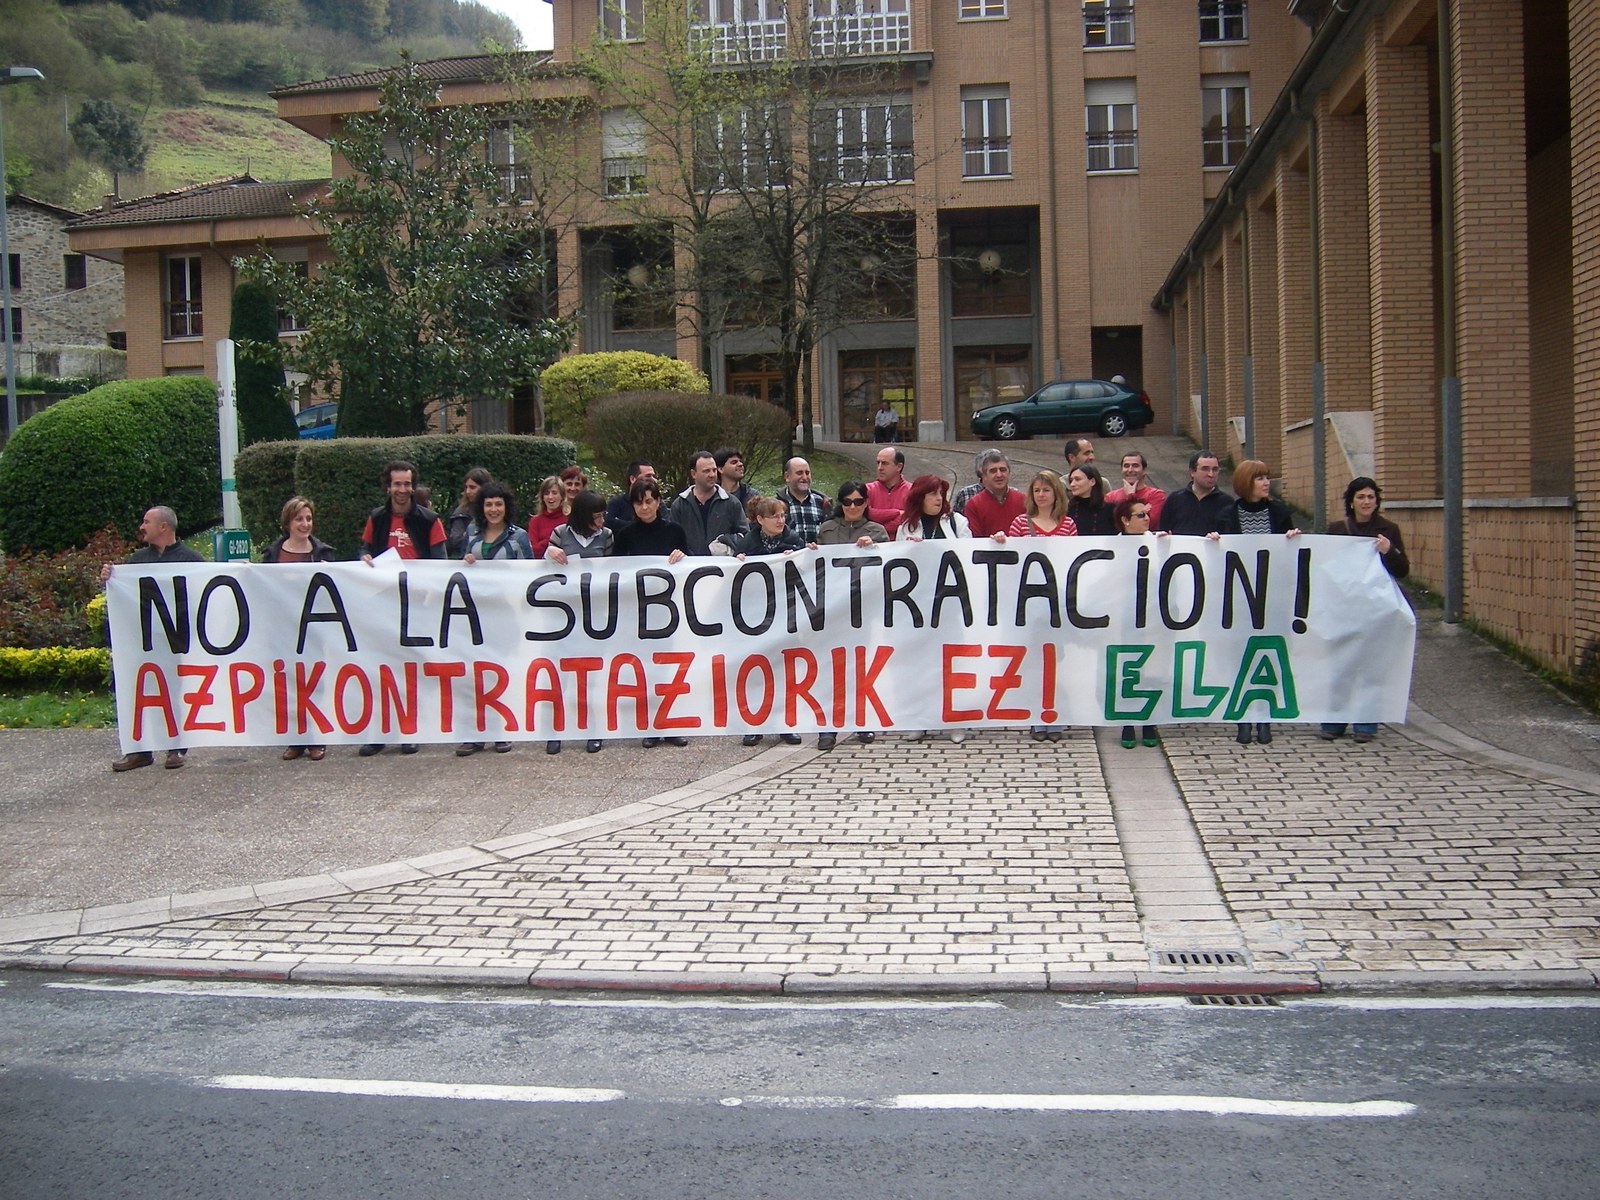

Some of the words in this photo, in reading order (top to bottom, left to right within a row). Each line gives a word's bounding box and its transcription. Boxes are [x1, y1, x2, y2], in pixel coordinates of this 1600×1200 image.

[229, 540, 249, 555] GI-2620
[138, 574, 250, 656] NO
[296, 571, 358, 655] A
[399, 570, 484, 649] LA
[942, 642, 1058, 725] EZ!
[1103, 635, 1300, 721] ELA
